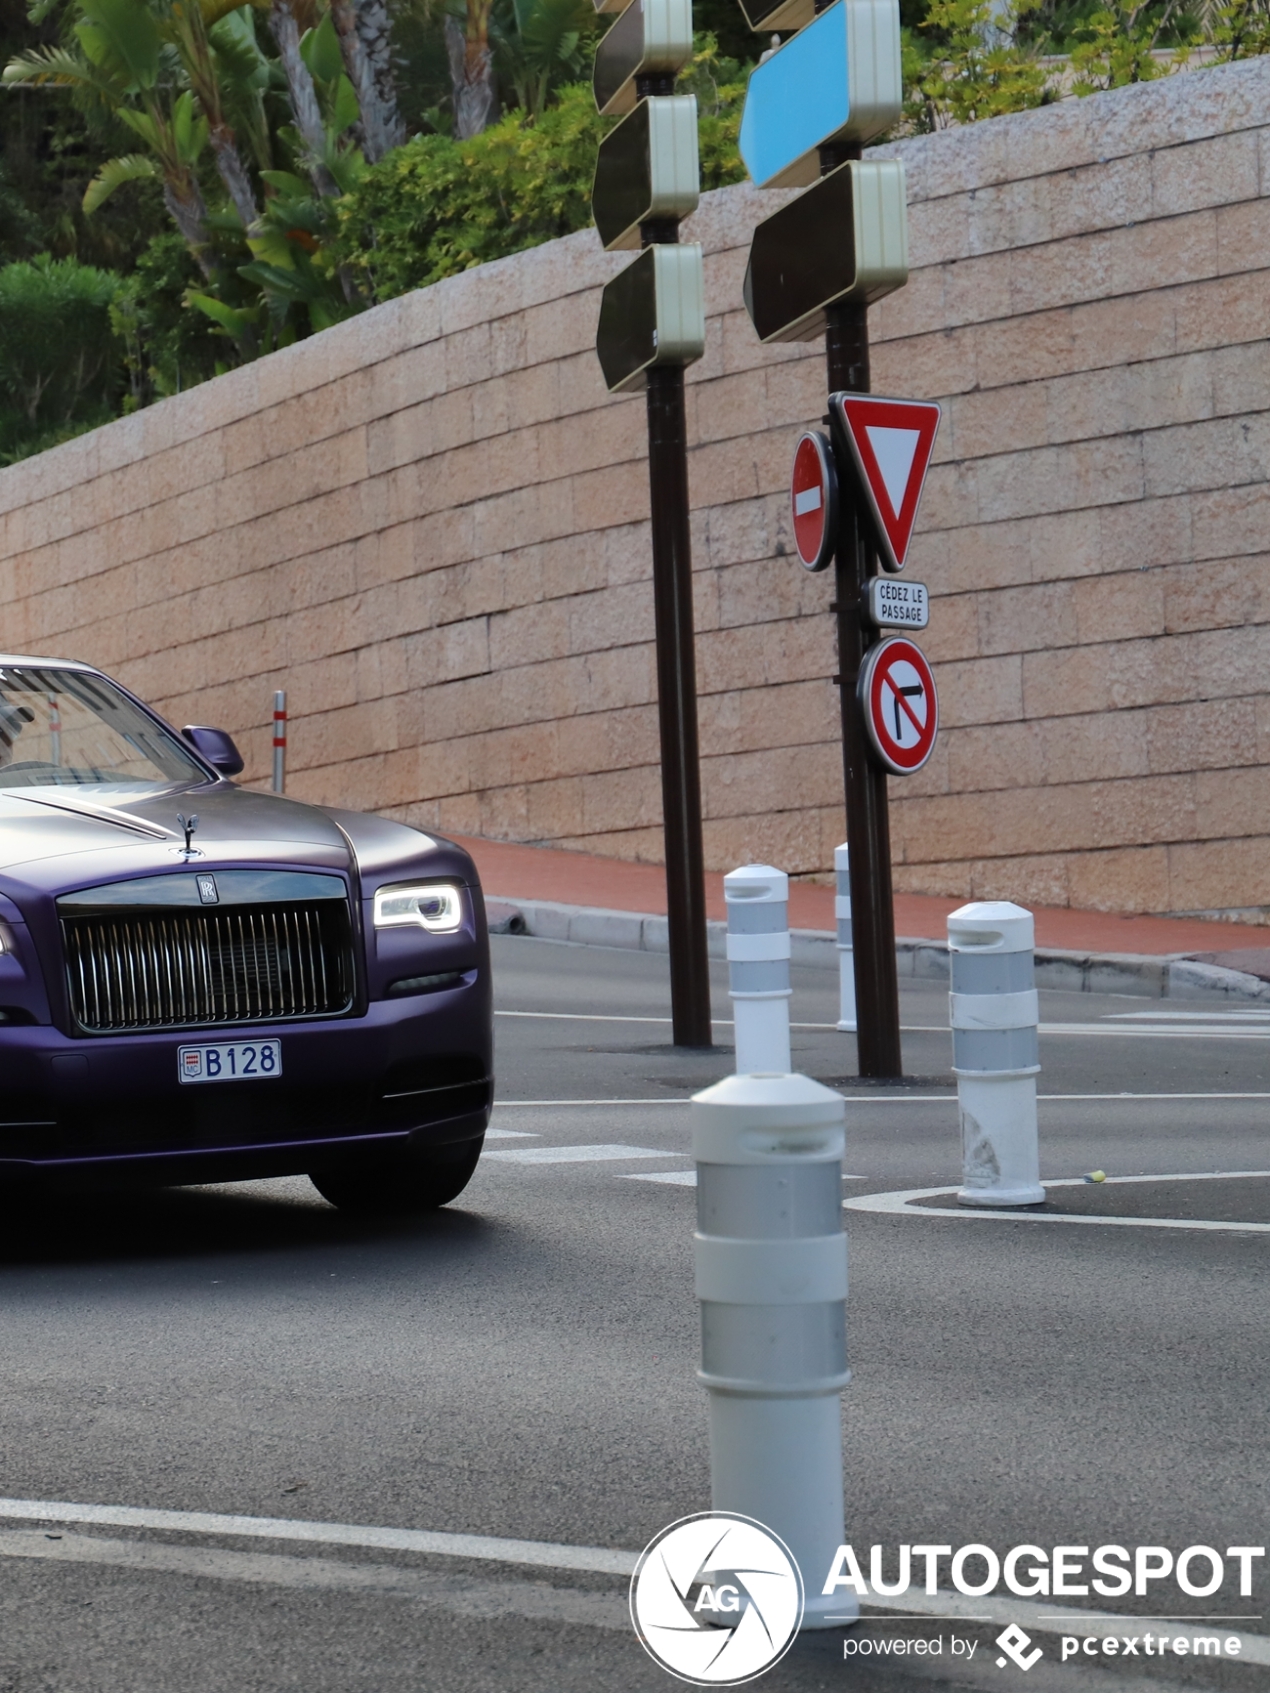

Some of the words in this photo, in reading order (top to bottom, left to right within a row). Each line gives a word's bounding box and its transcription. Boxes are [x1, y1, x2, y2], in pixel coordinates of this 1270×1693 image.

[880, 582, 909, 602] CÉDEZ
[912, 589, 923, 603] LE
[881, 604, 922, 622] PASSAGE
[186, 1065, 199, 1074] MC
[205, 1045, 276, 1077] B128
